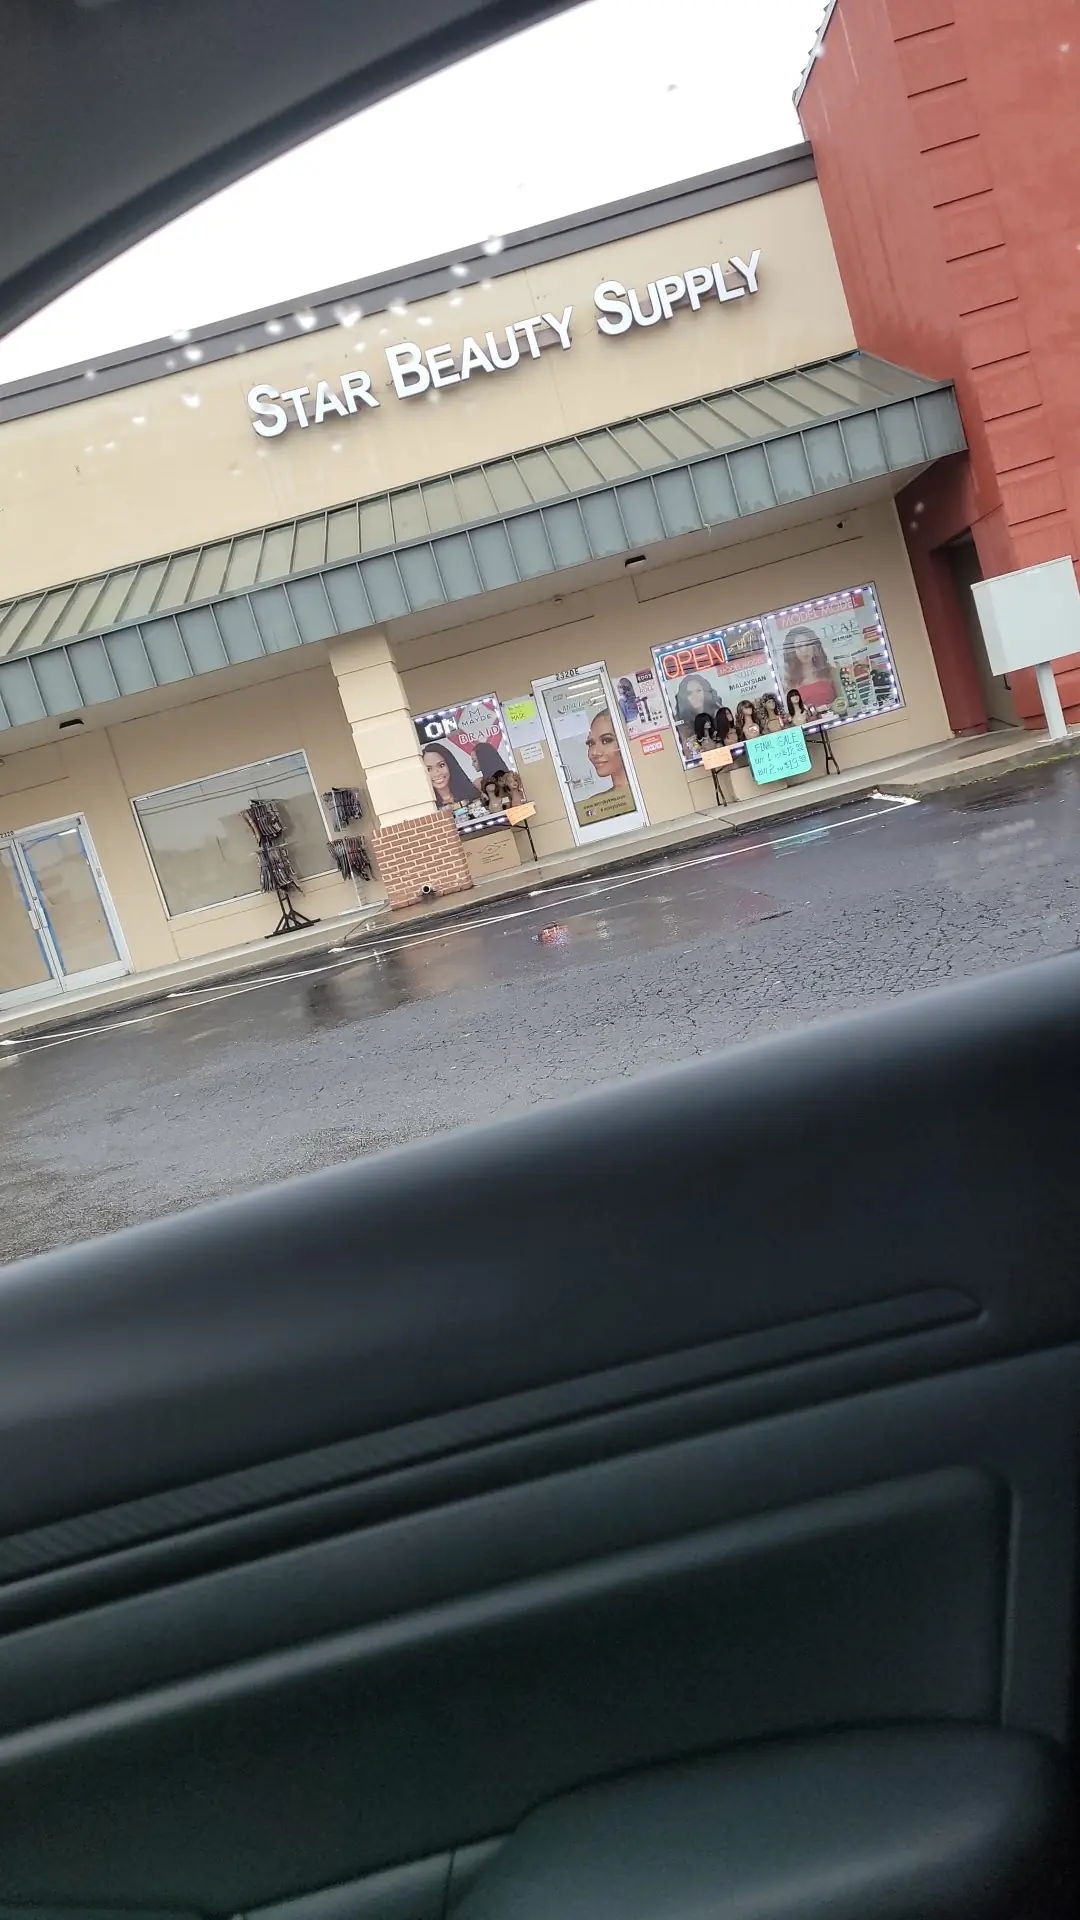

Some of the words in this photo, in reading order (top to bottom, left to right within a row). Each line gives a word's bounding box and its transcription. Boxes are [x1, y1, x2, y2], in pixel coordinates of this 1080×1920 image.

[384, 306, 574, 400] BEAUTY
[593, 249, 763, 336] SUPPLY
[663, 640, 725, 678] OPEN
[555, 668, 580, 681] 2320E
[729, 675, 767, 691] MALAYSIAN
[458, 724, 500, 744] BRAID
[777, 732, 798, 747] SALE
